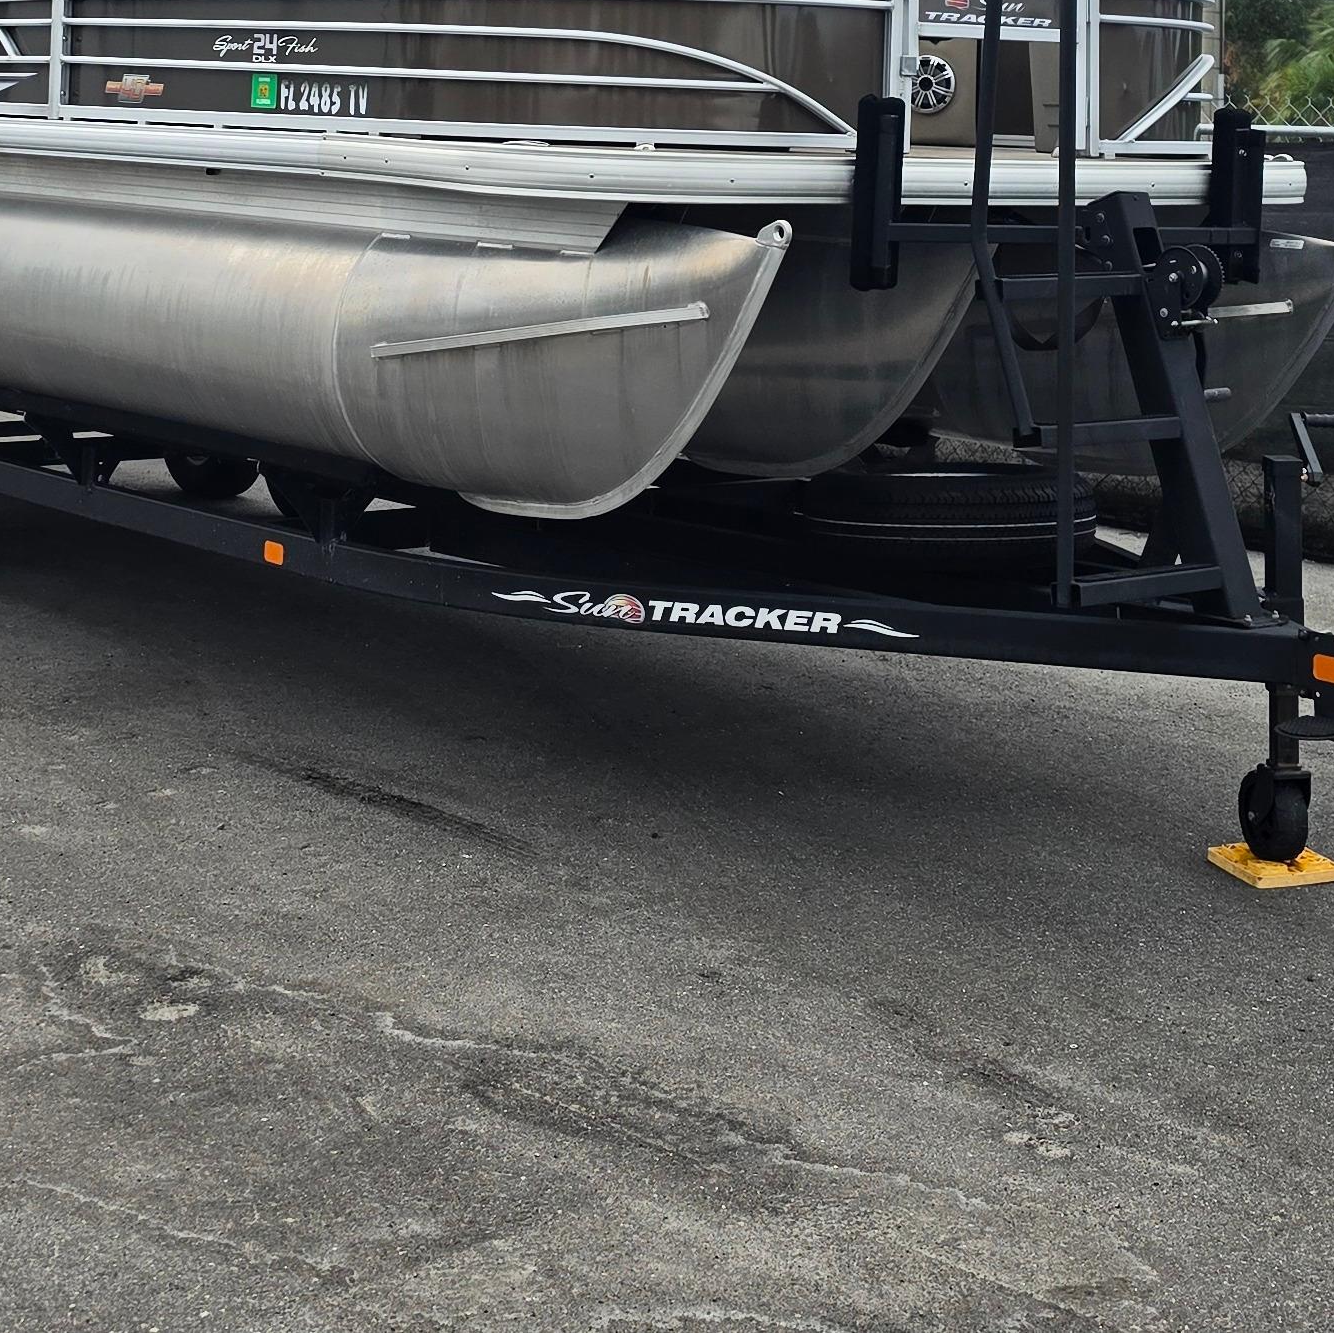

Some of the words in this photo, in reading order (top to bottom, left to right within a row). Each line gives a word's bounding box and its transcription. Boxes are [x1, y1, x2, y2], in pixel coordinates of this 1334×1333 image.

[213, 35, 254, 57] Sport
[253, 33, 278, 54] 24
[277, 36, 318, 56] Fish
[252, 55, 277, 63] DLX
[280, 79, 296, 111] FL
[299, 81, 341, 115] 2485
[543, 591, 635, 619] Sun
[648, 600, 842, 634] TRACKER
